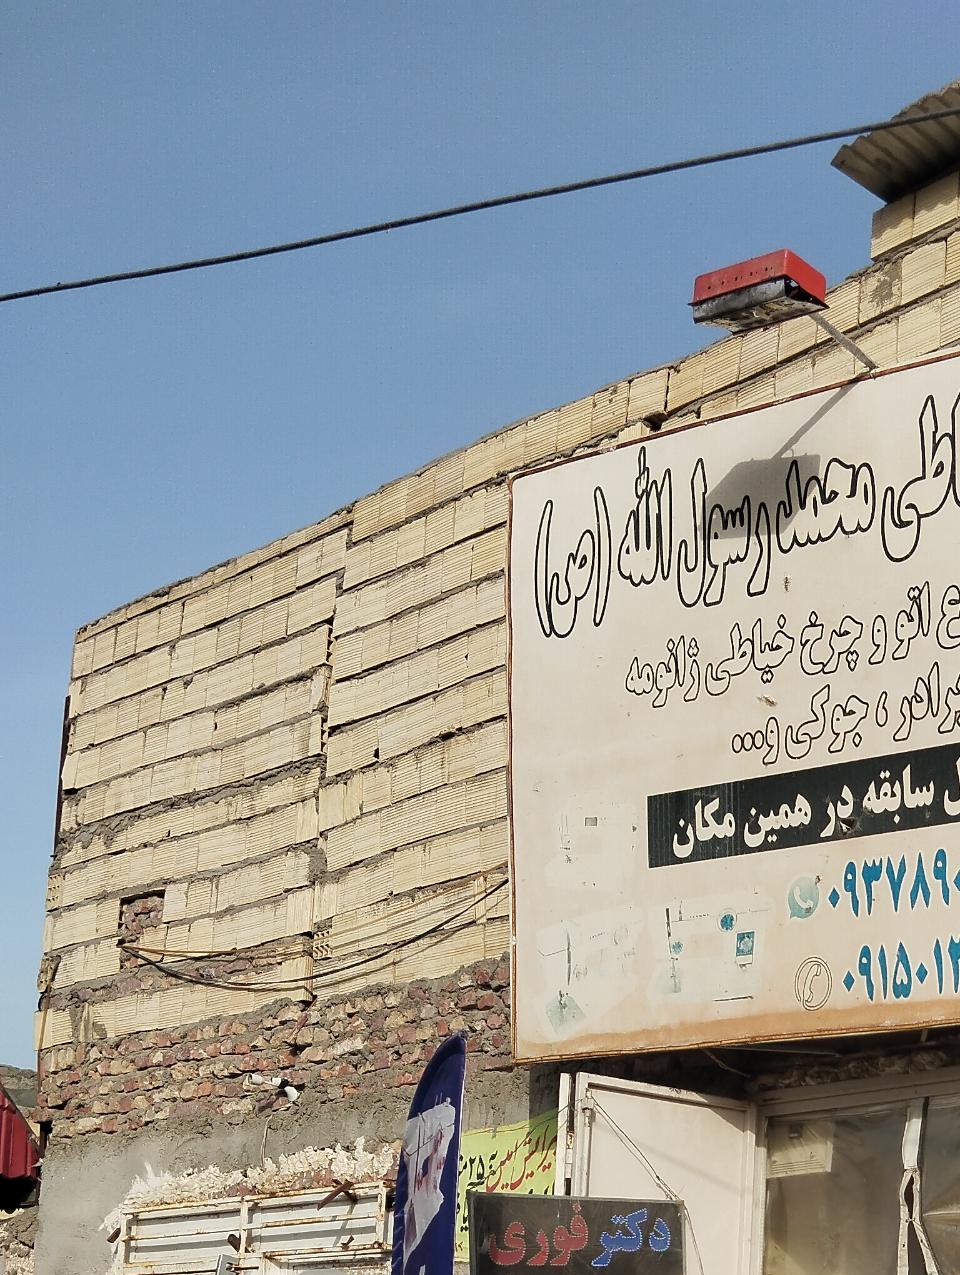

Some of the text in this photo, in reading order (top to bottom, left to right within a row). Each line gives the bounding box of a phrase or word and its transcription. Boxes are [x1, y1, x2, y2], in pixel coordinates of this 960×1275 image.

[618, 446, 672, 587] الله
[677, 457, 772, 609] رسول
[775, 459, 877, 554] محمد
[534, 486, 612, 638] (ص)
[799, 610, 864, 675] چرخ
[868, 615, 888, 664] و
[892, 581, 930, 660] اتو
[704, 614, 795, 696] خیاطی
[785, 684, 869, 759] جوکی
[743, 794, 812, 847] همین
[820, 785, 854, 838] در
[862, 763, 934, 824] سابقه
[672, 798, 735, 858] مکان
[488, 1203, 589, 1266] فوری
[591, 1208, 672, 1267] دکتر
